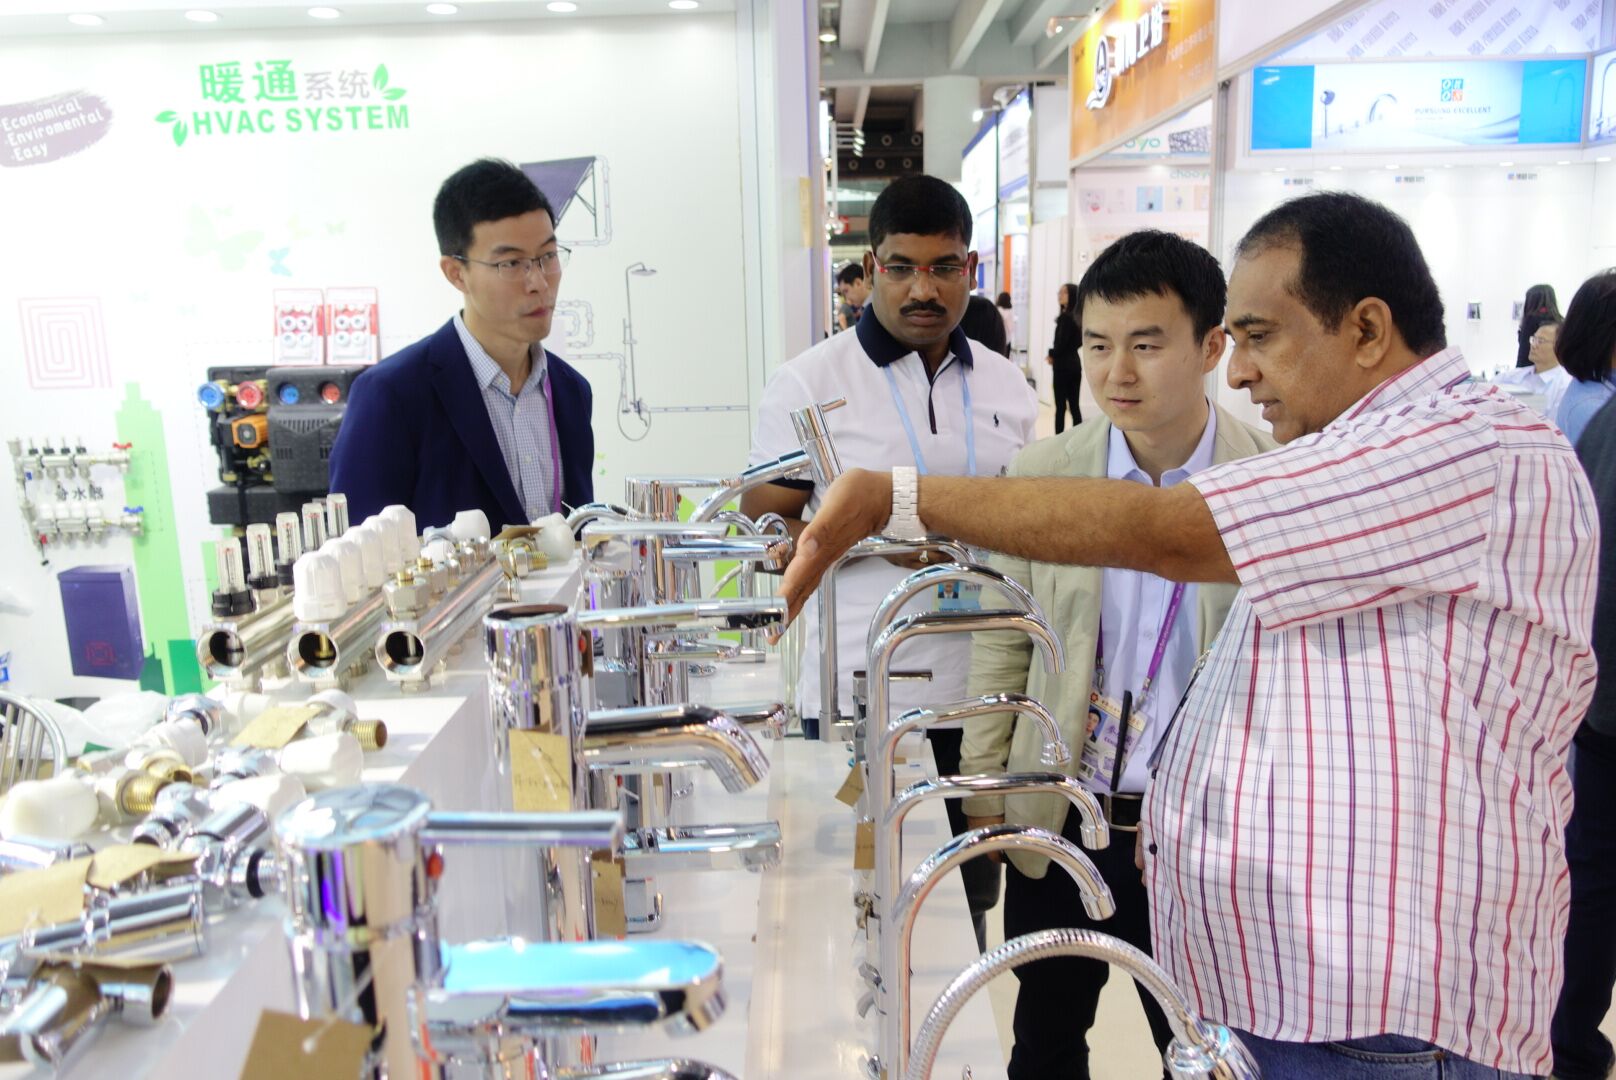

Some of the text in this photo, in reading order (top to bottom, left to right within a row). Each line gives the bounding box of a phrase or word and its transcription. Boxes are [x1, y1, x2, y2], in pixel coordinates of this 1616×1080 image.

[199, 60, 370, 104] 暖通系统
[1, 98, 82, 132] Economical
[192, 104, 410, 136] HVAC SYSTEM
[1453, 106, 1492, 114] EXCELLENT
[7, 108, 105, 147] Enviromental
[13, 142, 48, 161] Easy
